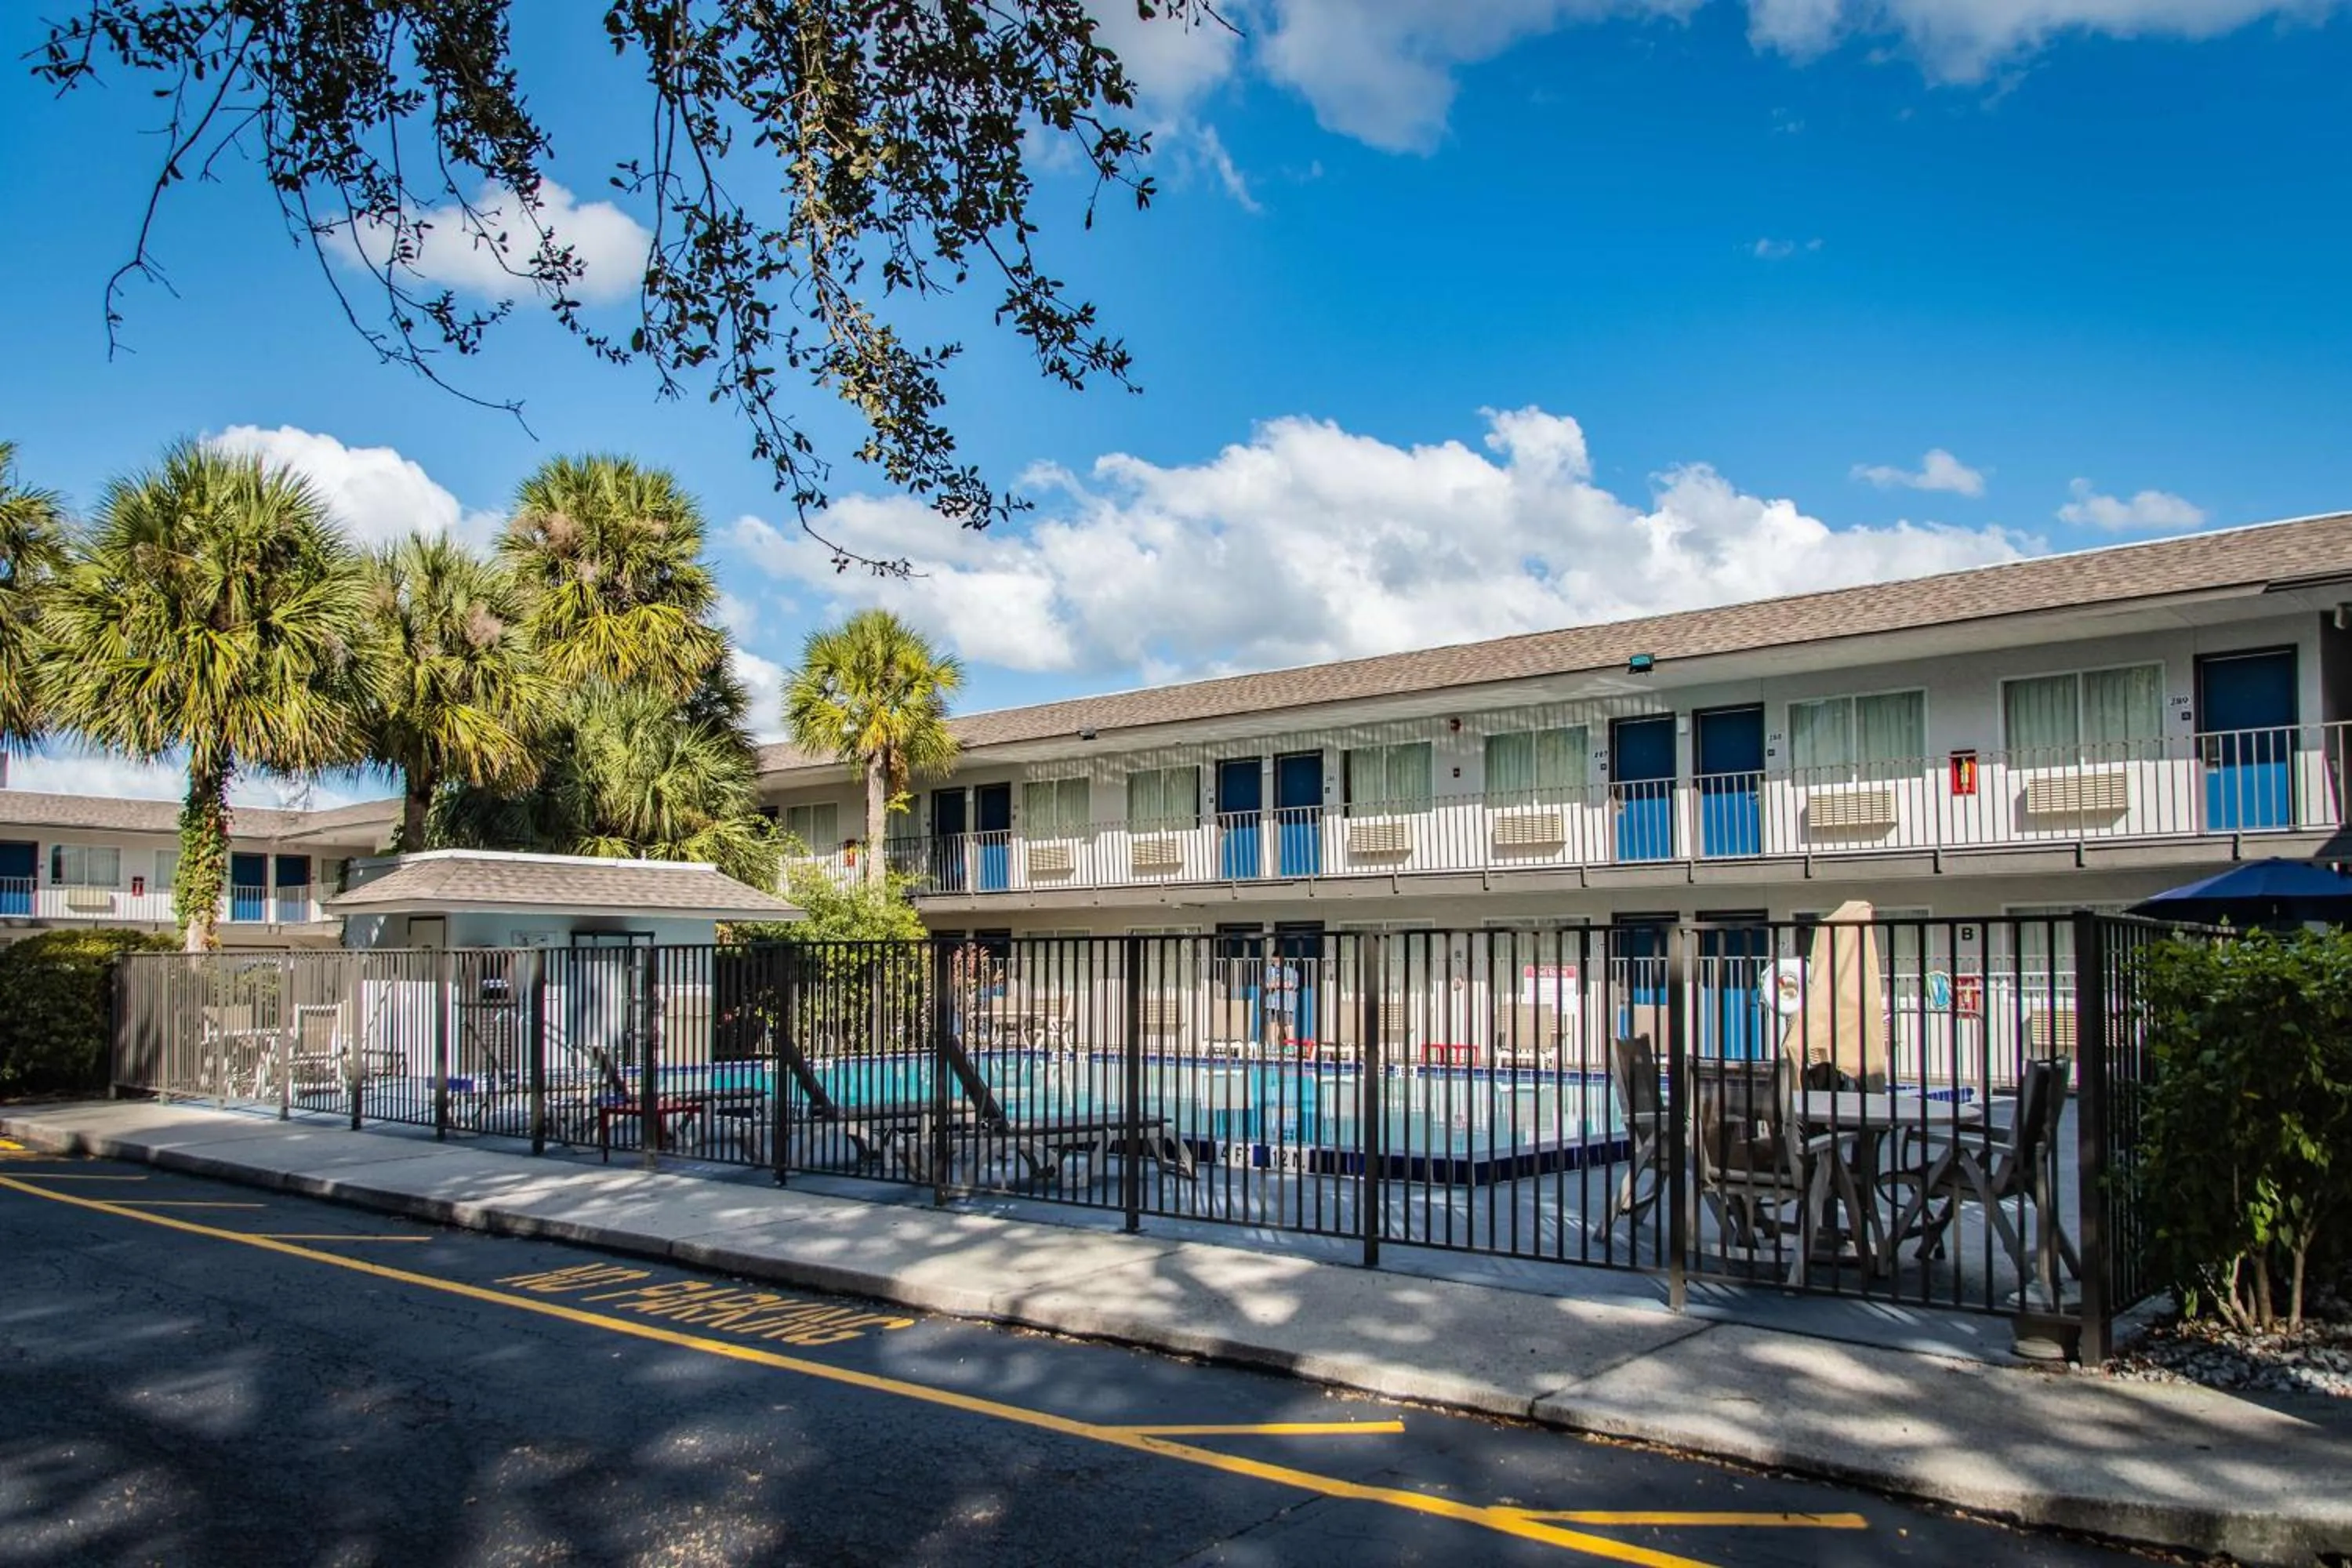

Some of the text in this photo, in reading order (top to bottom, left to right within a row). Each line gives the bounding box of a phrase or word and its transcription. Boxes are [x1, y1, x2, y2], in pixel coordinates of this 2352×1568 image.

[1962, 927, 1973, 940] B
[493, 1262, 915, 1345] NO PARKING
